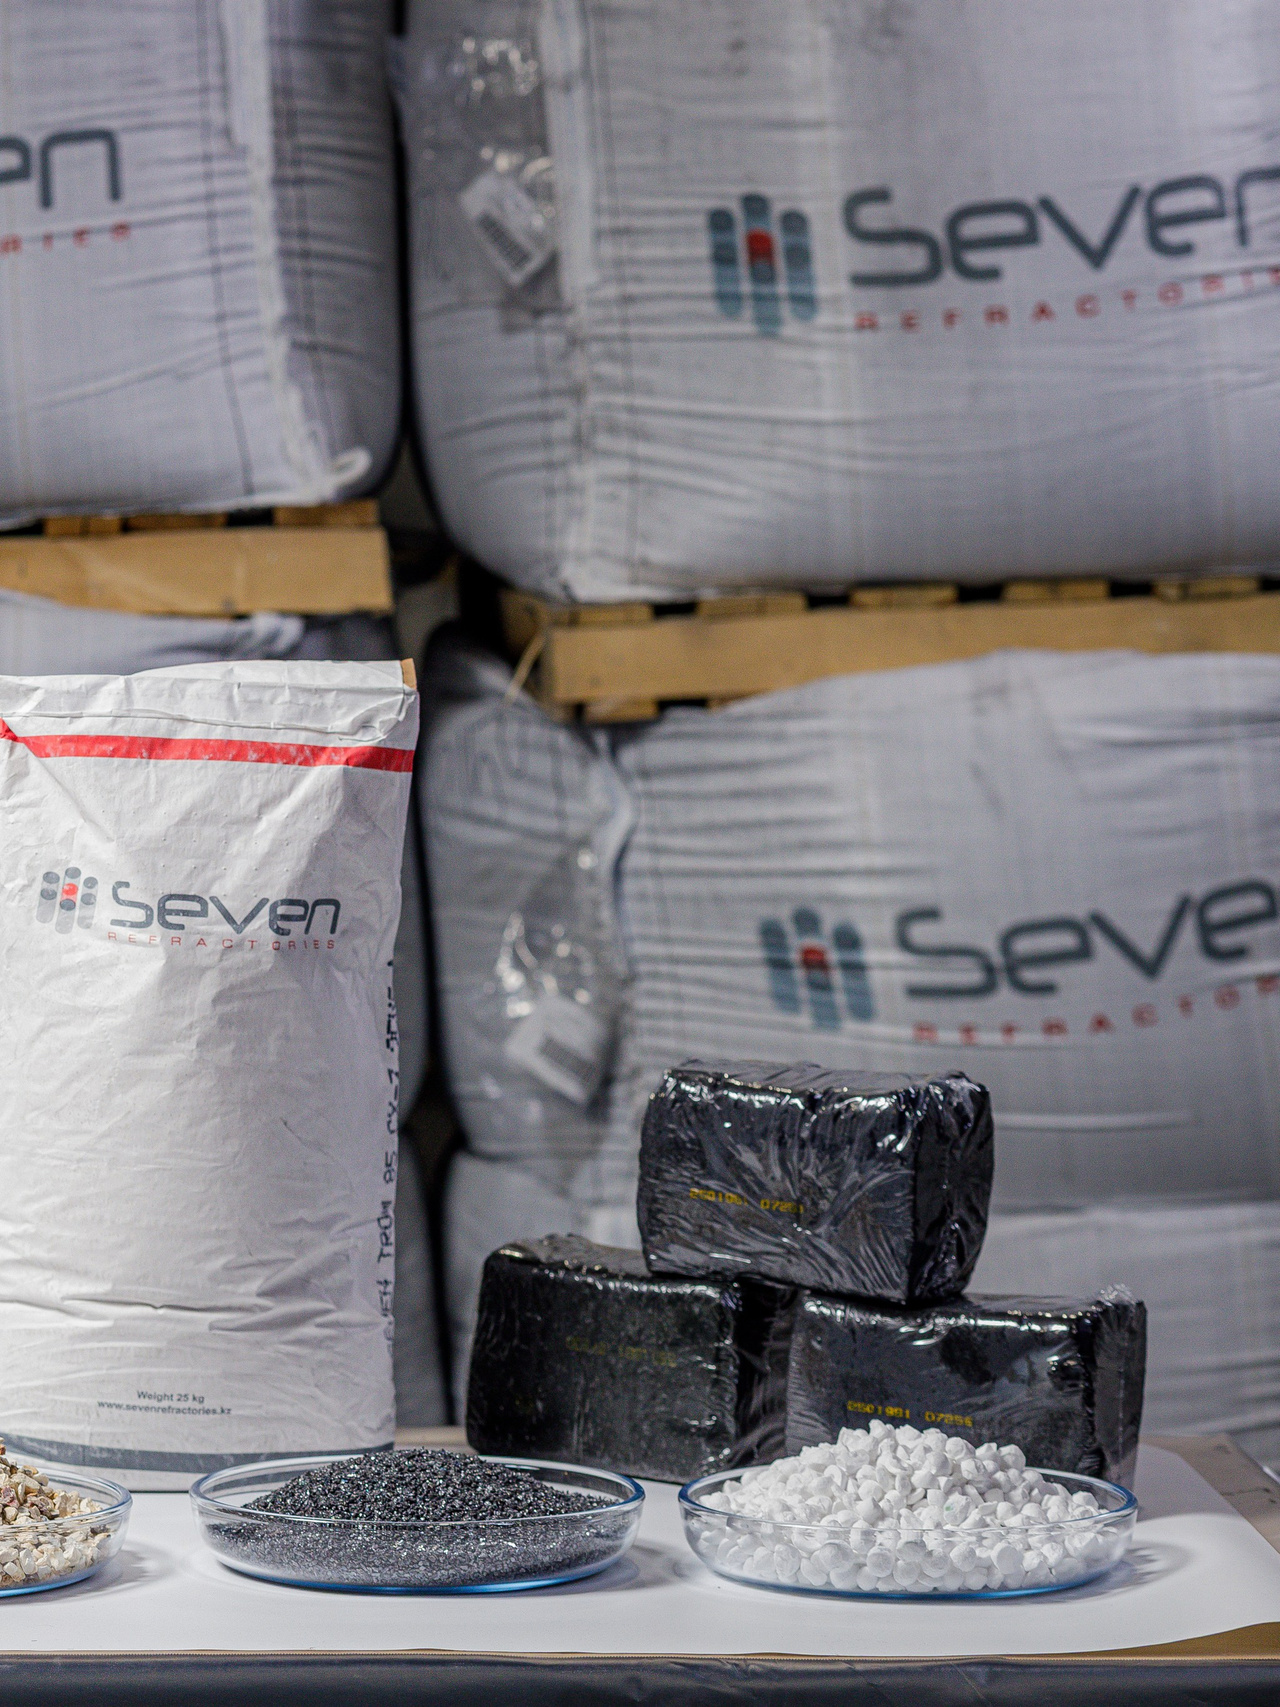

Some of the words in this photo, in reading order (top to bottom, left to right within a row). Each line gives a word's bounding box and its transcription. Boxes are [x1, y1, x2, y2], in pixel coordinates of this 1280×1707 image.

[110, 880, 342, 937] Seven
[108, 931, 336, 951] REFRACTORIES
[136, 1390, 174, 1403] Weight
[176, 1393, 189, 1402] 25
[192, 1393, 205, 1404] kg
